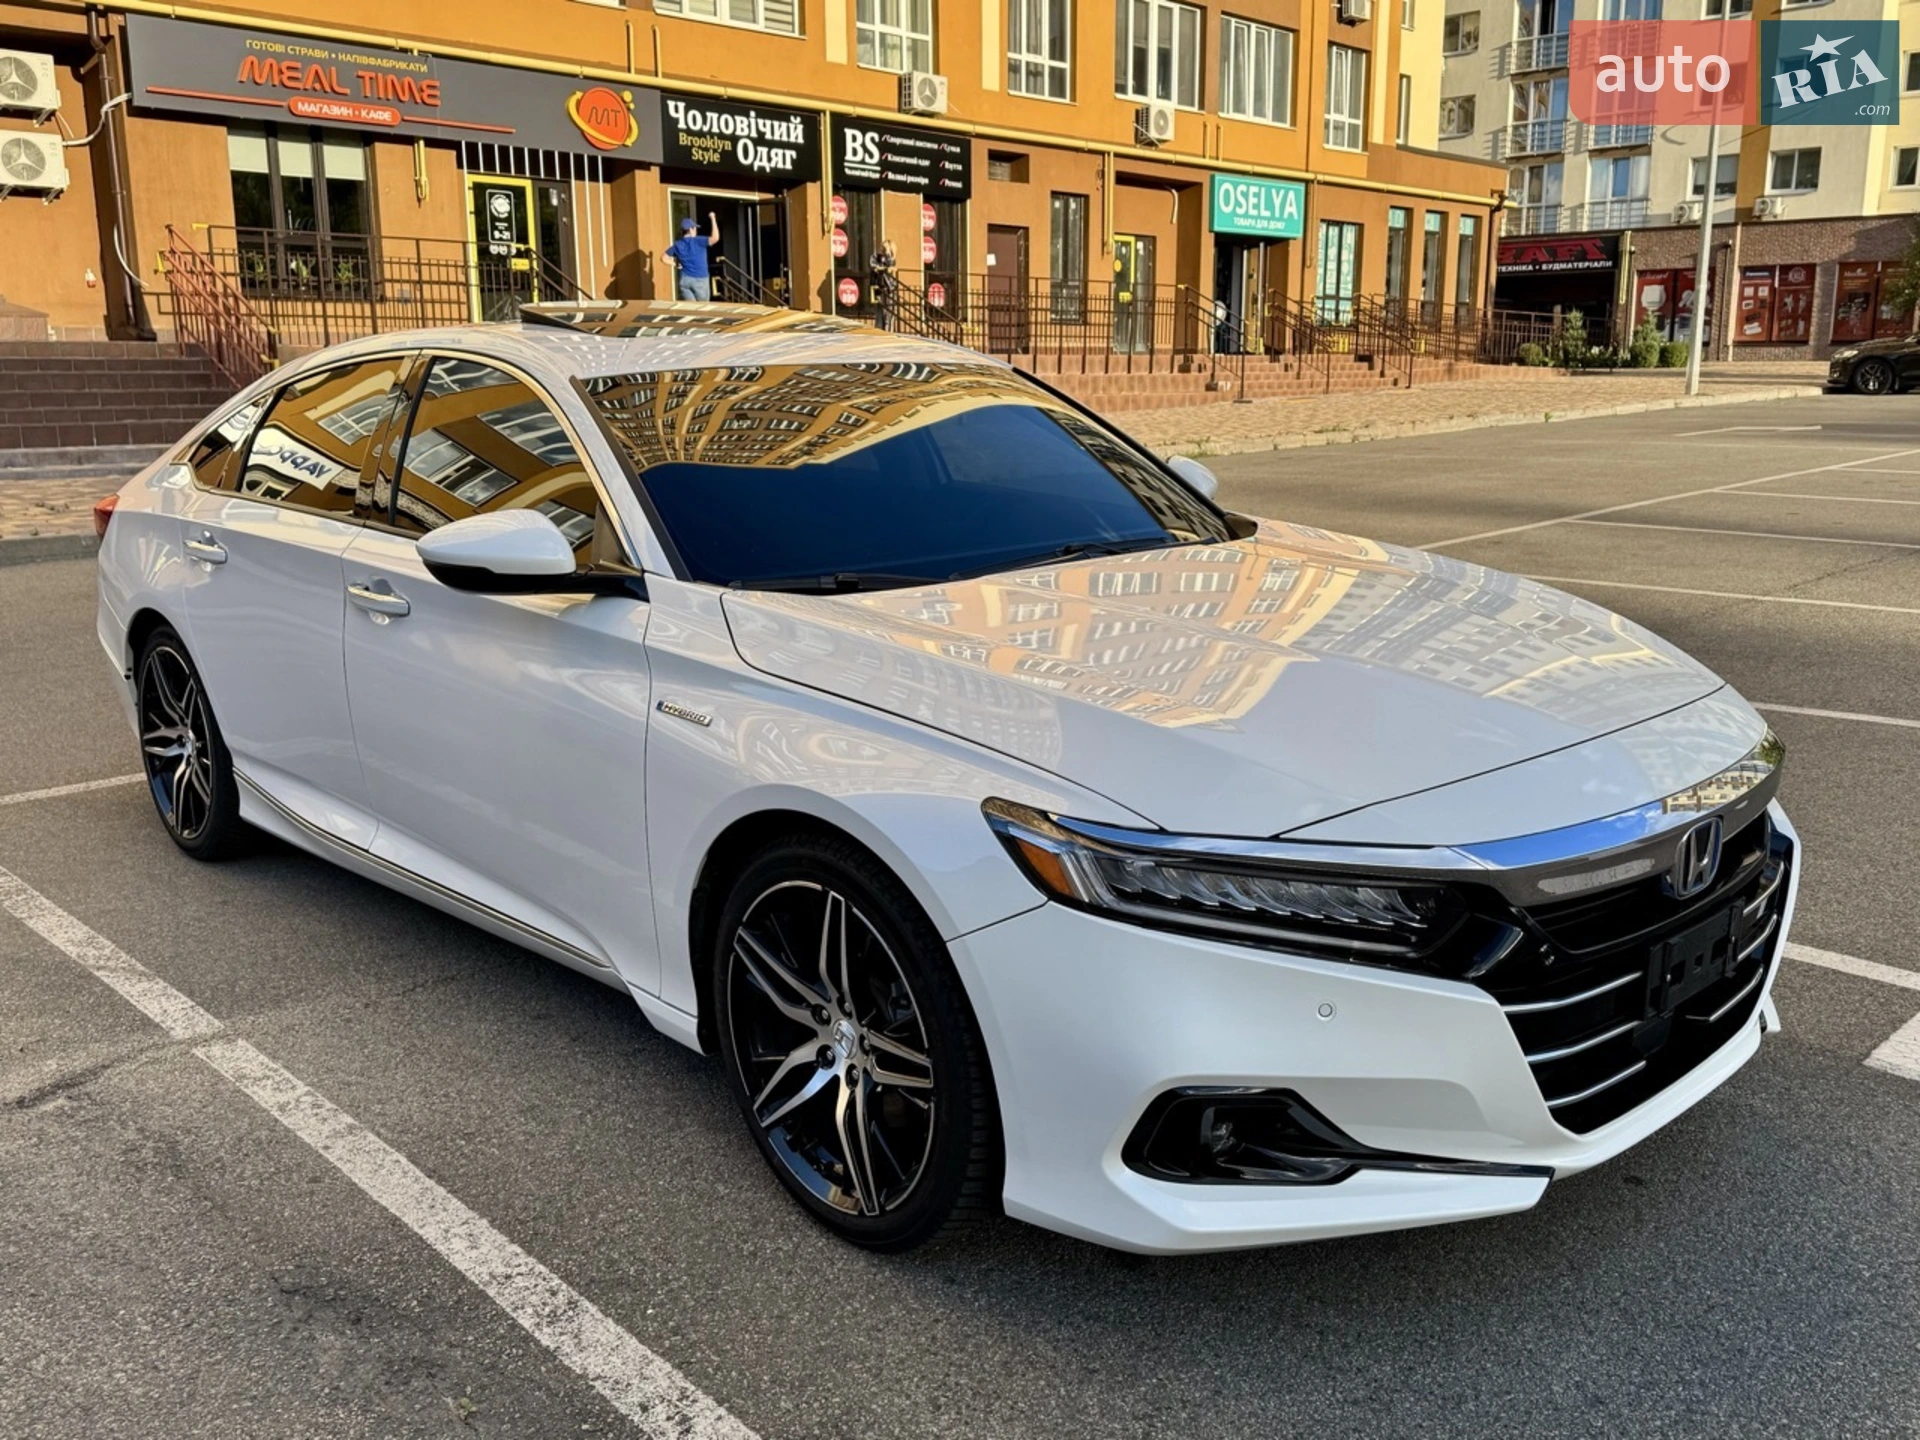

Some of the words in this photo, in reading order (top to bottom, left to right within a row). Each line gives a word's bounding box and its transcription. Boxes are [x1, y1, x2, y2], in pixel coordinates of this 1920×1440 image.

[245, 39, 286, 53] ГОТОВІ
[287, 45, 329, 59] СТРАВИ
[338, 53, 428, 73] НАПІВФАБРИКАТИ
[237, 55, 350, 96] MEAL
[356, 70, 441, 106] TIME
[297, 102, 353, 117] МАГАЗИН
[361, 110, 393, 122] КАФЕ
[666, 99, 805, 145] Чоловічий
[679, 133, 732, 151] Brooklyn
[691, 146, 721, 165] Style
[737, 138, 797, 173] Одяг
[843, 127, 880, 165] BS
[1219, 181, 1299, 220] OSELYA
[1541, 261, 1613, 271] БУДМАТЕРІАЛИ
[664, 703, 707, 723] HYBRID
